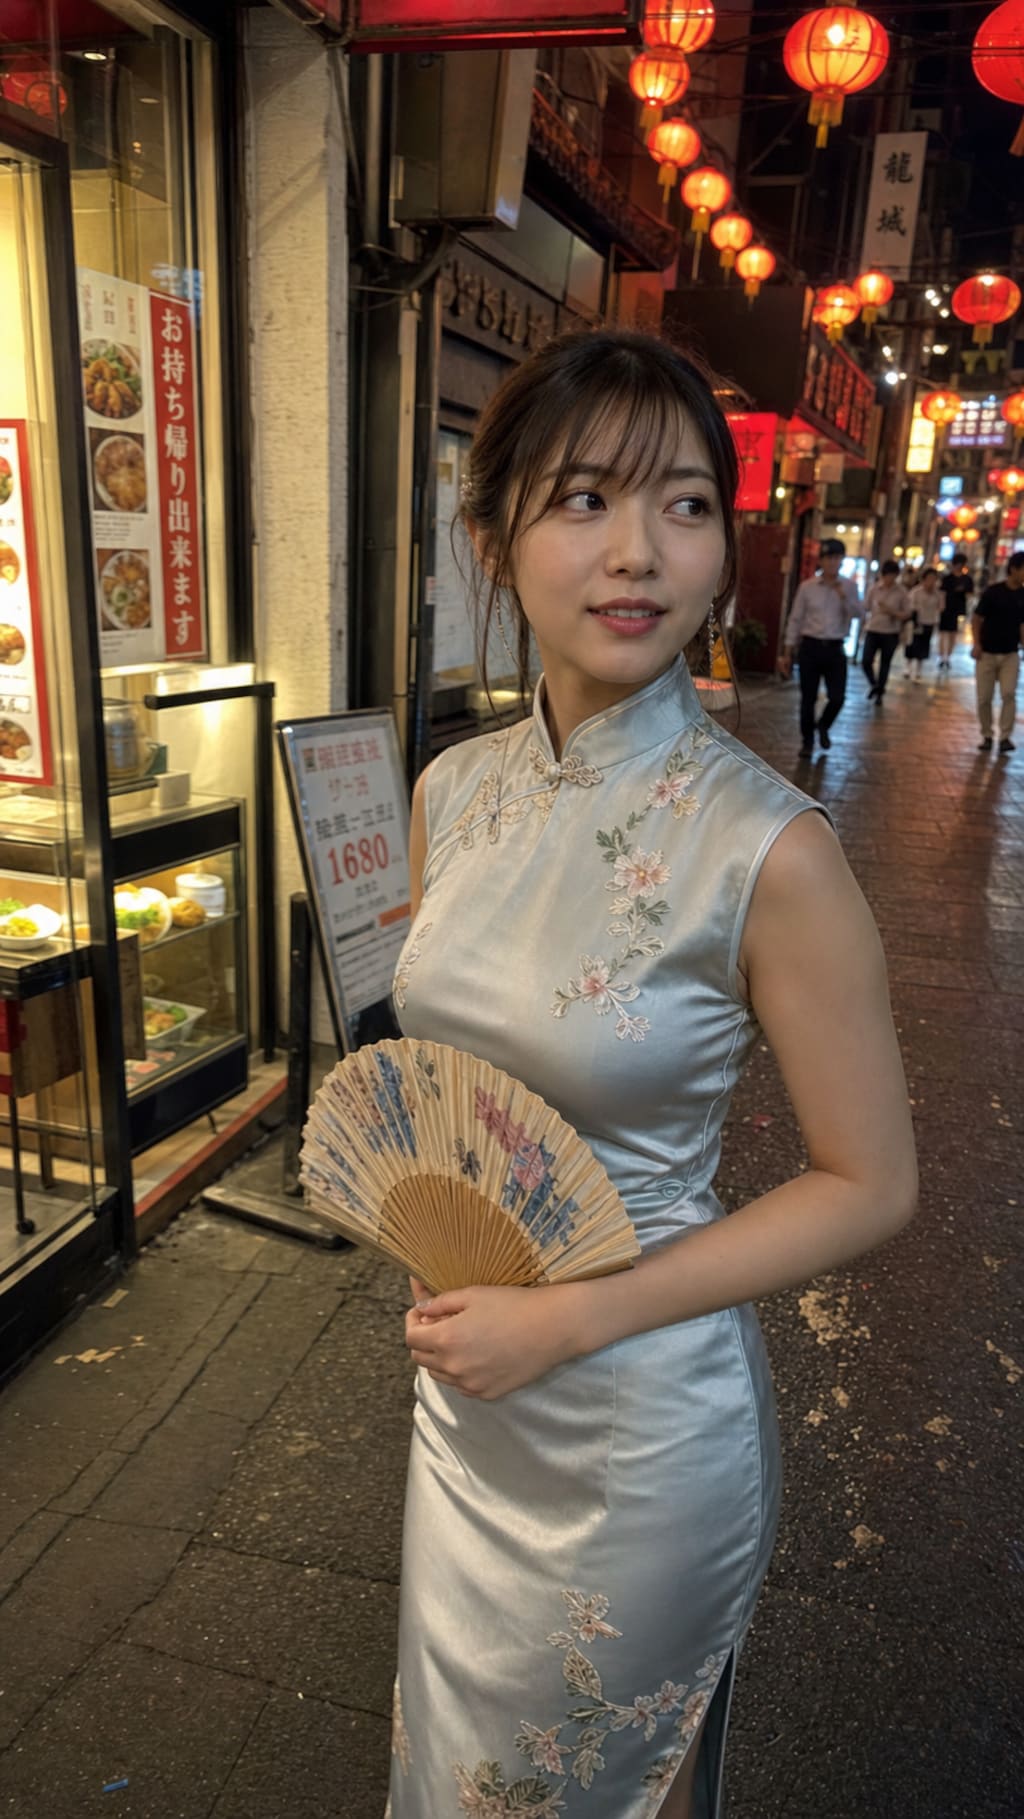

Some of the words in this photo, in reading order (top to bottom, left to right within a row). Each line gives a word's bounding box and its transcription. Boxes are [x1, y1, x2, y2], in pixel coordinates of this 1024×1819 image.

[875, 151, 914, 238] 龍城
[160, 308, 195, 646] お持ち帰り出来ます
[328, 833, 389, 886] 1680
